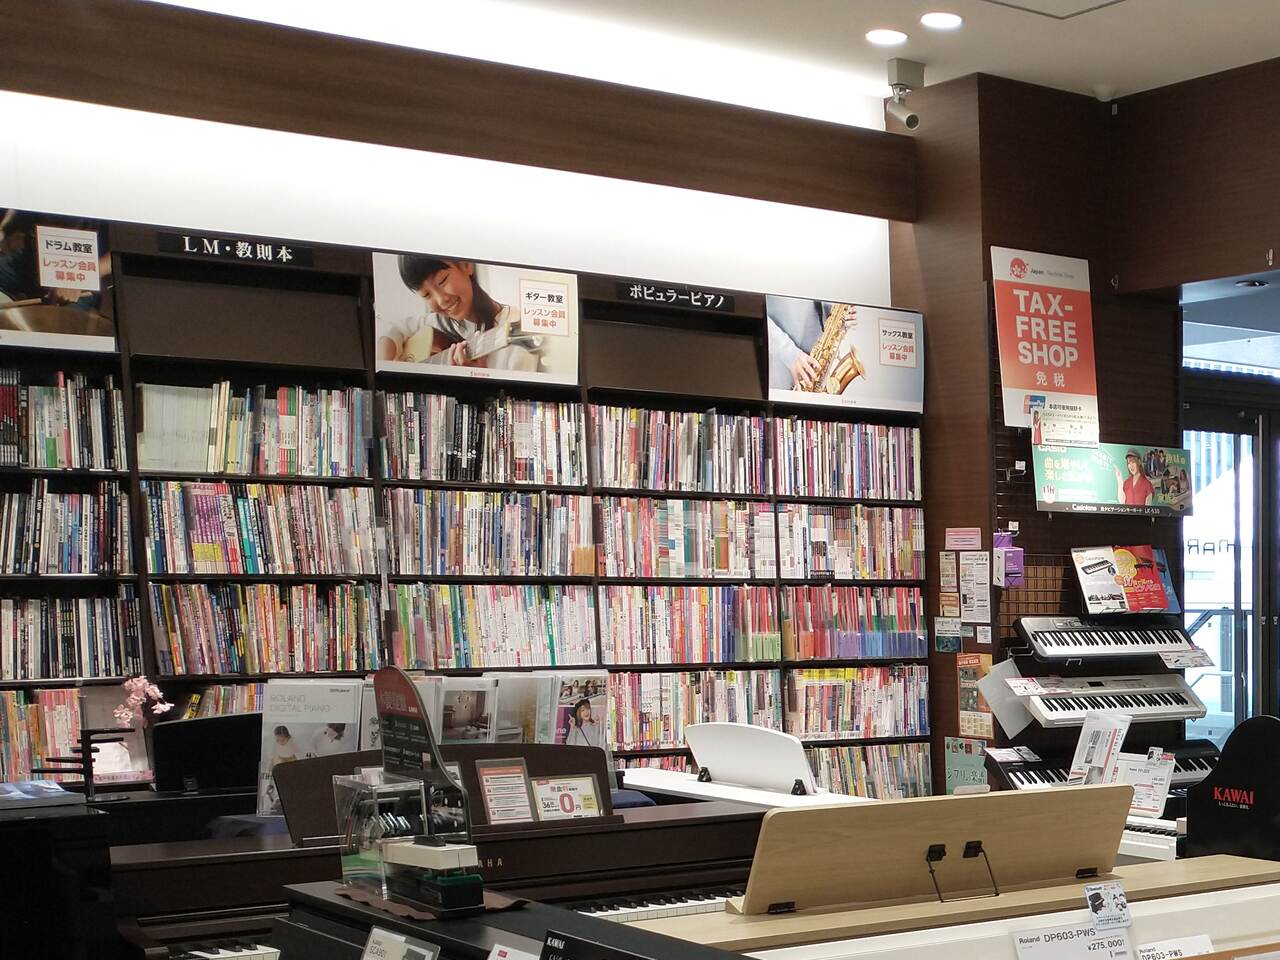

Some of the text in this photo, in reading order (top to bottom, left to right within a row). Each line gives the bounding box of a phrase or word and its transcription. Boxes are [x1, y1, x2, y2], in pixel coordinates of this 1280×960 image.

[44, 239, 93, 254] ドラム教室
[43, 258, 96, 272] レッスン会員
[55, 271, 86, 282] 募集中
[525, 292, 564, 304] ギター教室
[629, 285, 725, 308] ポピュラーピアノ
[1013, 289, 1073, 316] TAX-
[524, 307, 566, 319] レッスン会員
[533, 318, 557, 328] 募集中
[1016, 315, 1077, 343] FREE
[882, 330, 913, 339] サックス教室
[1018, 341, 1078, 368] SHOP
[1036, 371, 1065, 387] 免税
[1214, 787, 1254, 804] KAWAI
[547, 937, 565, 949] KAWAI
[1019, 928, 1096, 945] Roland DP603-PWS
[1139, 946, 1156, 954] Roland
